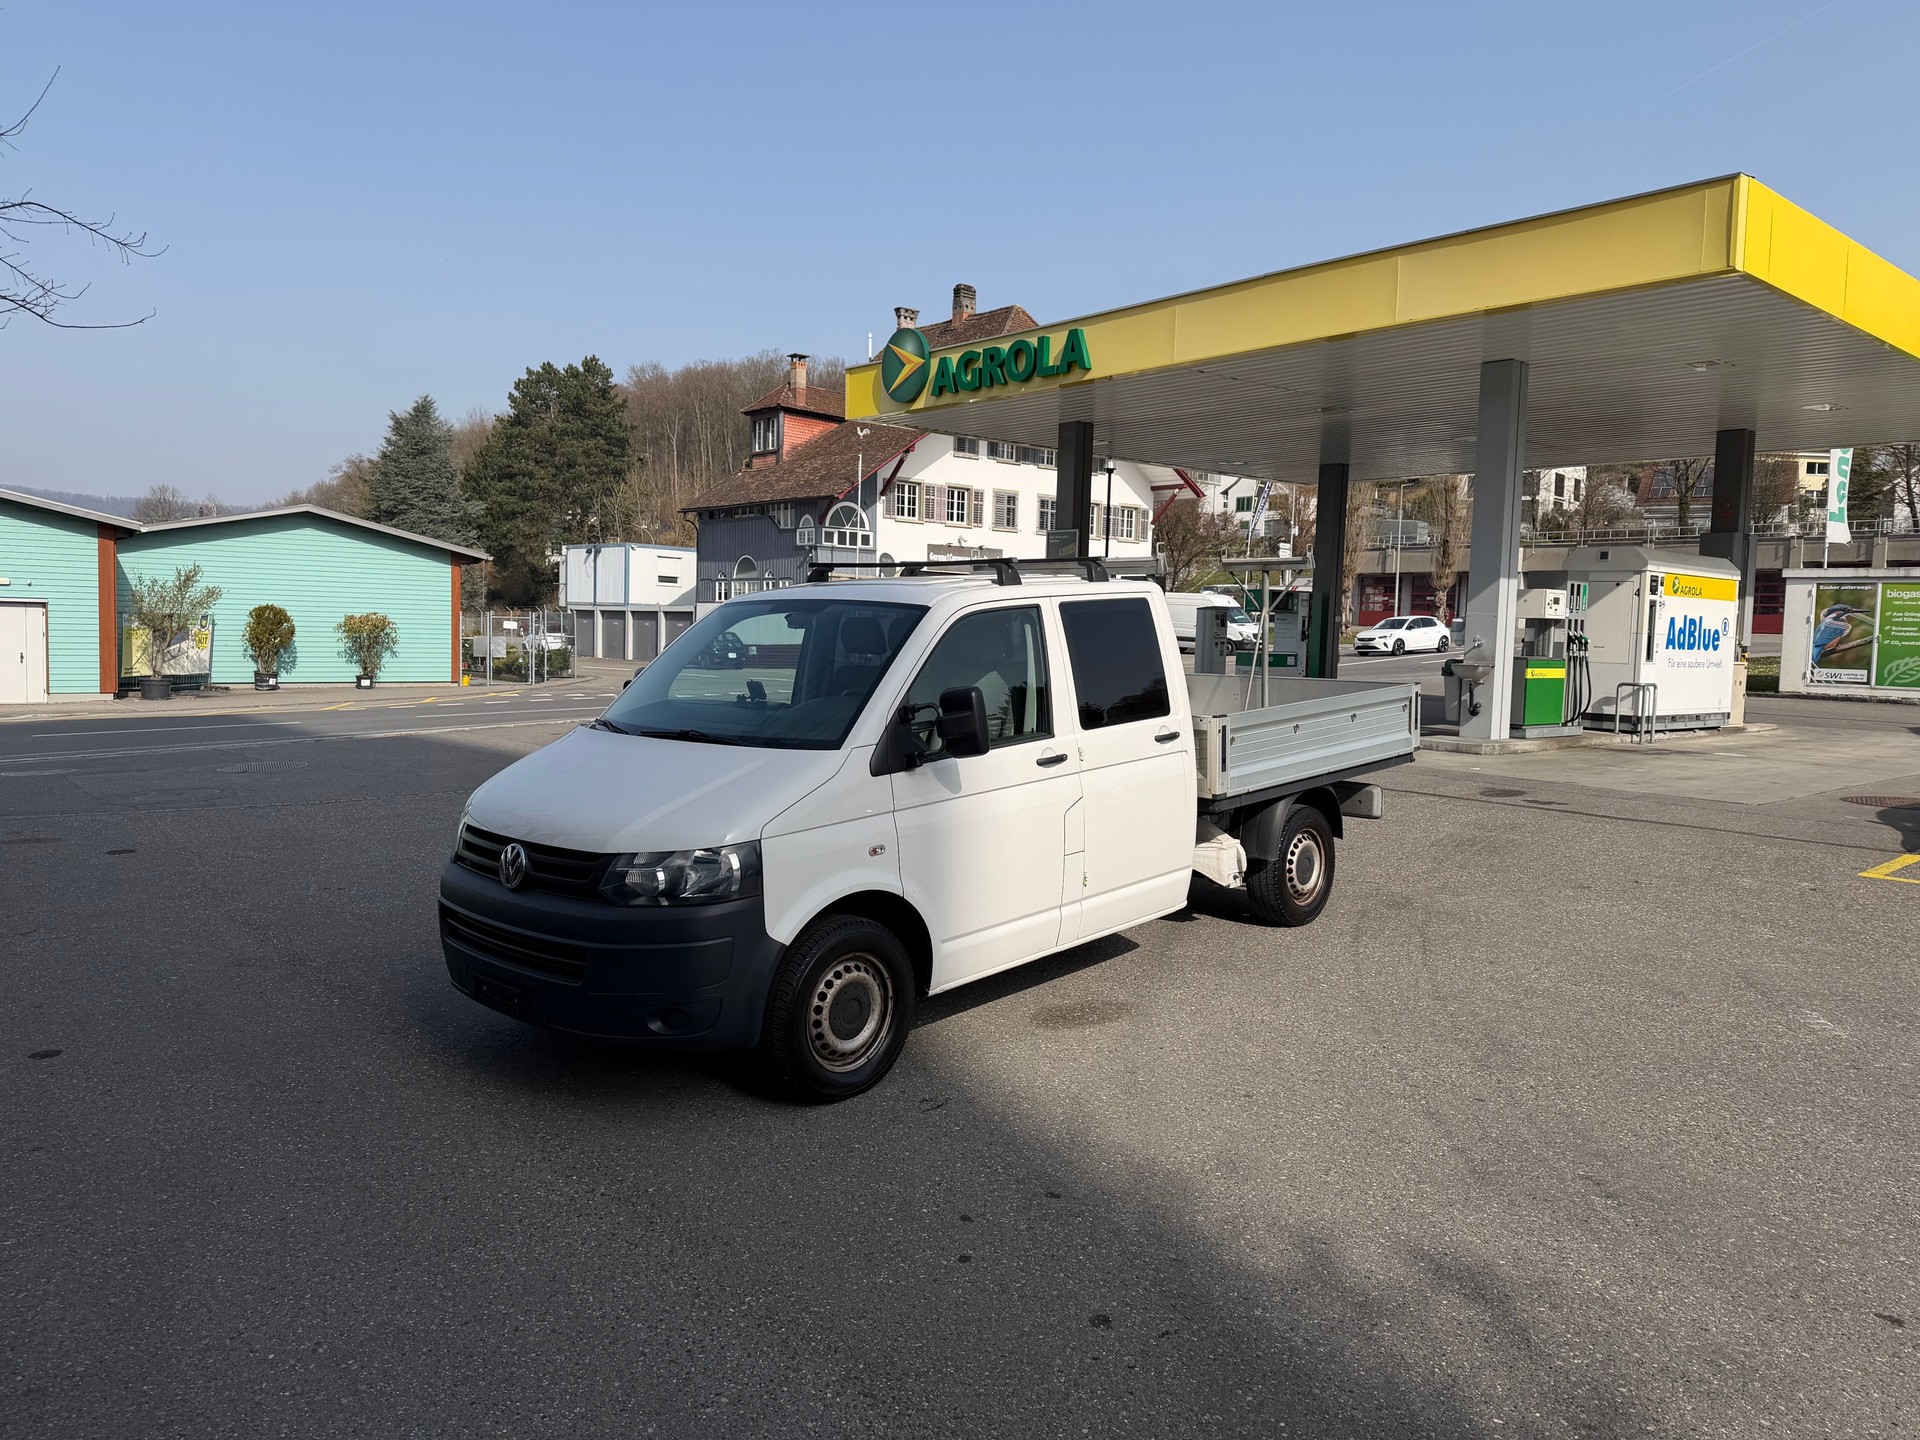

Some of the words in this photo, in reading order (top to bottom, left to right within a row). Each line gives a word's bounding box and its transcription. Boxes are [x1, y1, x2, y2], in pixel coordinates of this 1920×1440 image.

[931, 328, 1092, 397] AGROLA
[1680, 586, 1703, 596] AGROLA
[1677, 659, 1687, 668] eine
